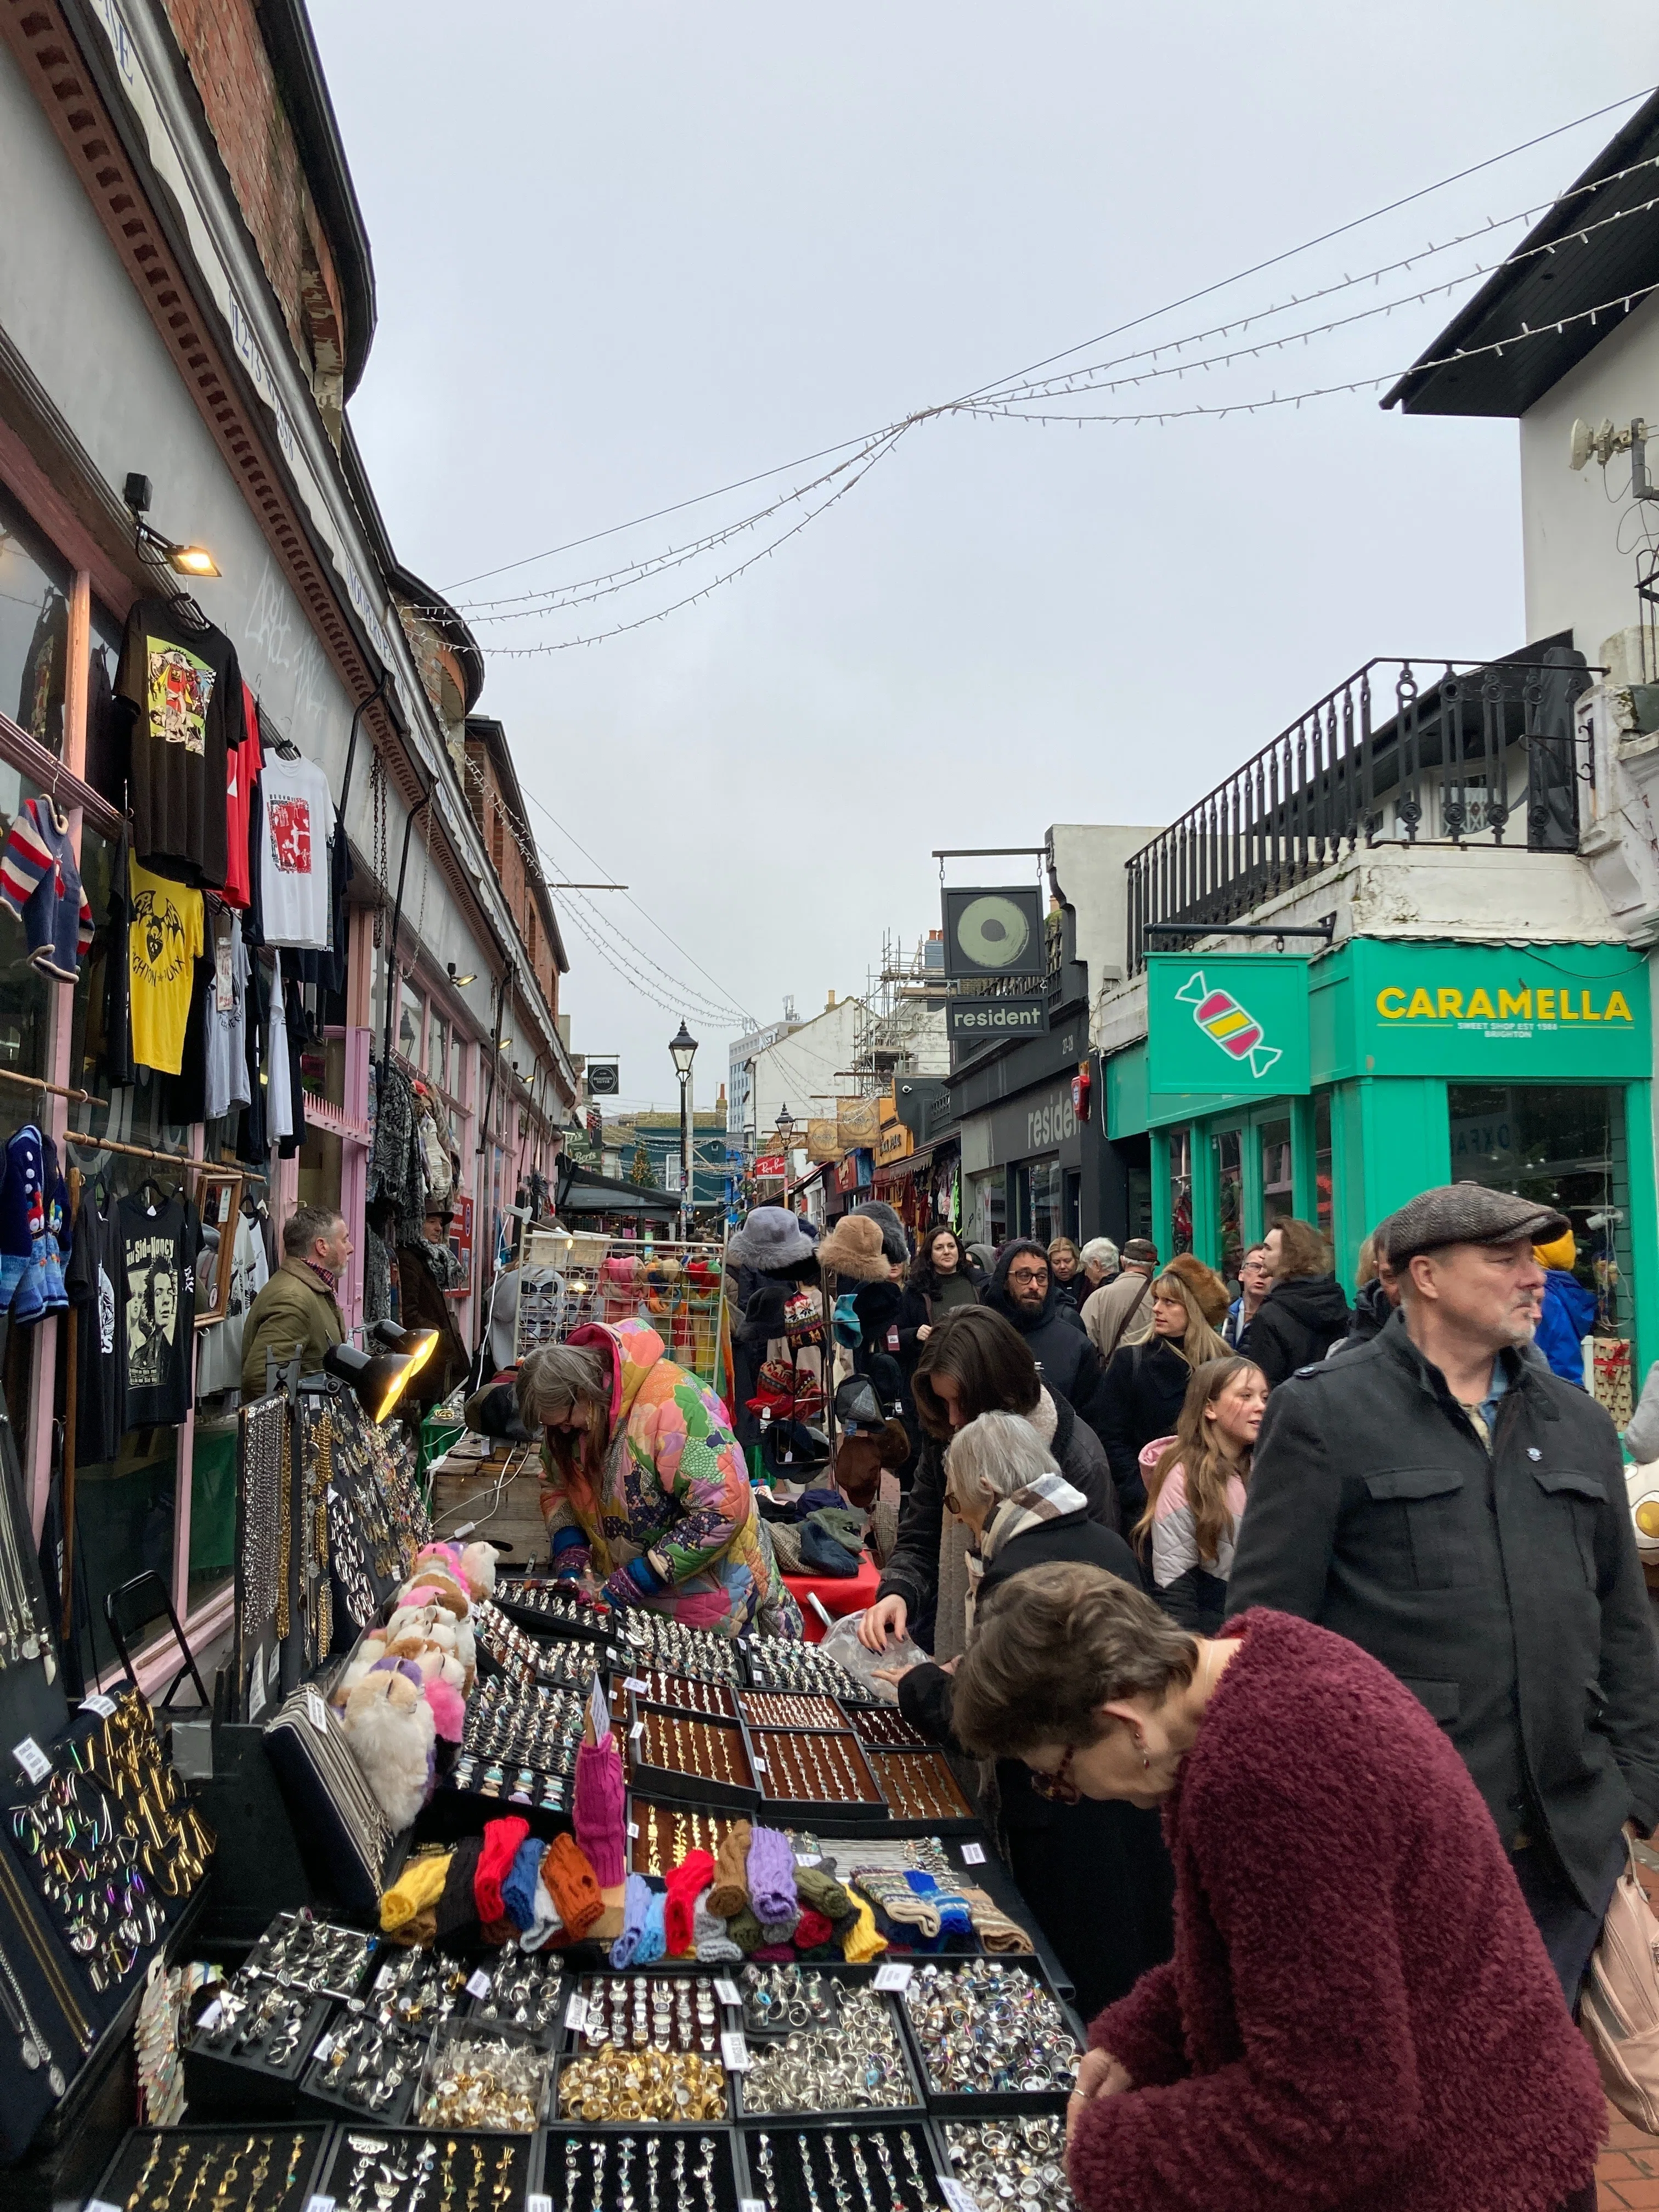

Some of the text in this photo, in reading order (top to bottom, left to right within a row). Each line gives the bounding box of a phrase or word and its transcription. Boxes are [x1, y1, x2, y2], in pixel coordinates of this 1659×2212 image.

[132, 946, 157, 988] GHTON
[954, 1007, 1041, 1028] resident
[1376, 986, 1634, 1022] CARAMELLA
[1062, 1034, 1074, 1055] 27-28
[1028, 1091, 1081, 1149] residen
[151, 1236, 174, 1259] Nancy
